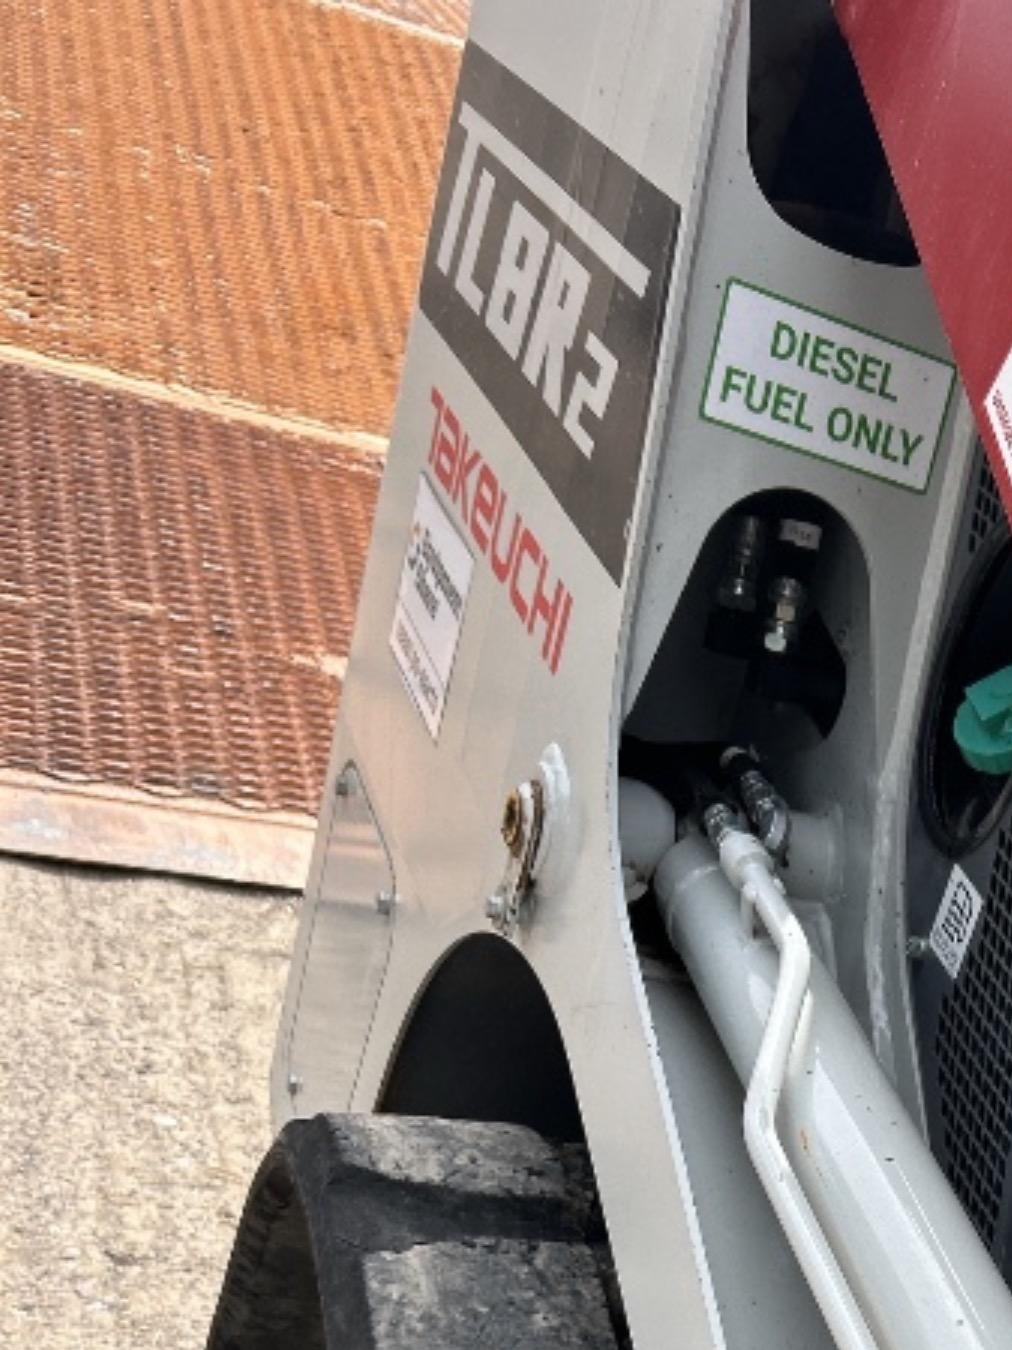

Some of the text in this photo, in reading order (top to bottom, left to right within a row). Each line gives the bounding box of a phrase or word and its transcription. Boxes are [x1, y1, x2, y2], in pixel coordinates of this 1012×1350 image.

[770, 320, 898, 403] DIESEL
[720, 365, 924, 466] FUEL ONLY
